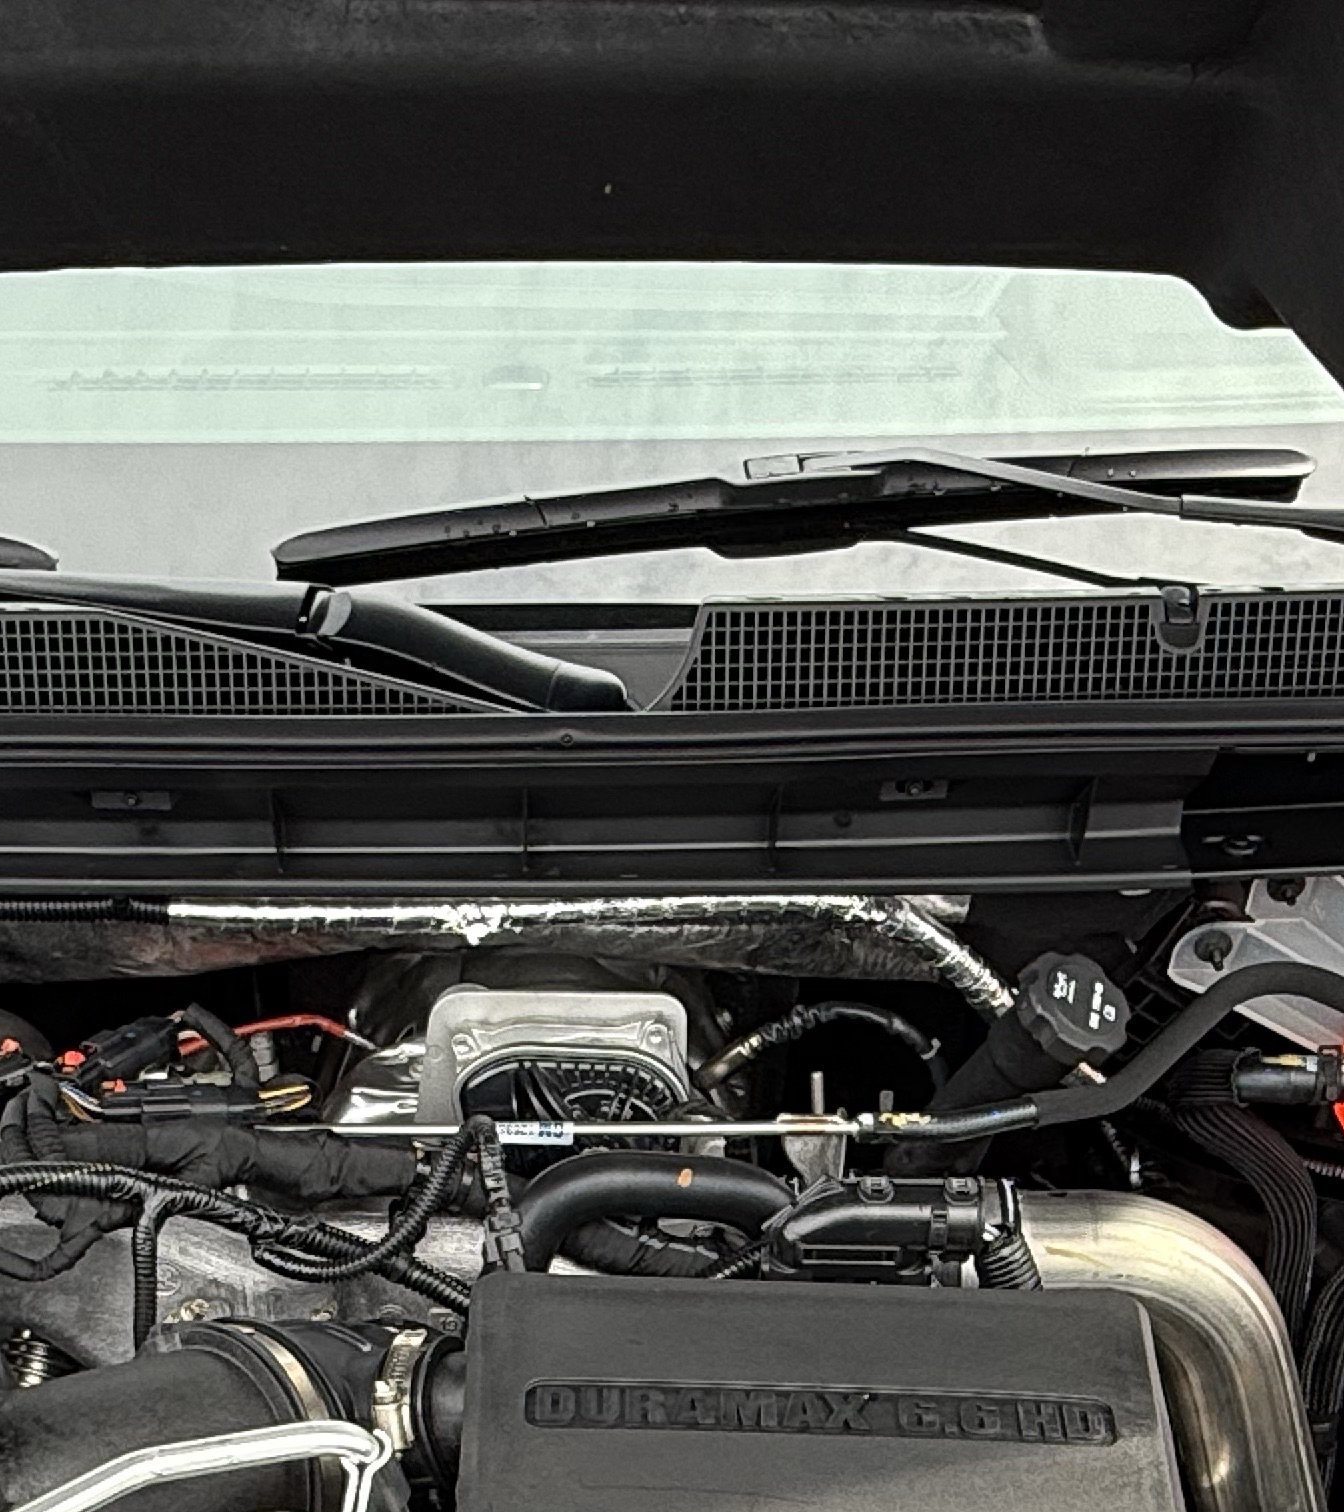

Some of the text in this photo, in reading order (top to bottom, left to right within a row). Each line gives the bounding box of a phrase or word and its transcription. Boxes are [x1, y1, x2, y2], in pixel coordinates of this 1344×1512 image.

[534, 1385, 1107, 1441] DURAMAX 6.6 HD
